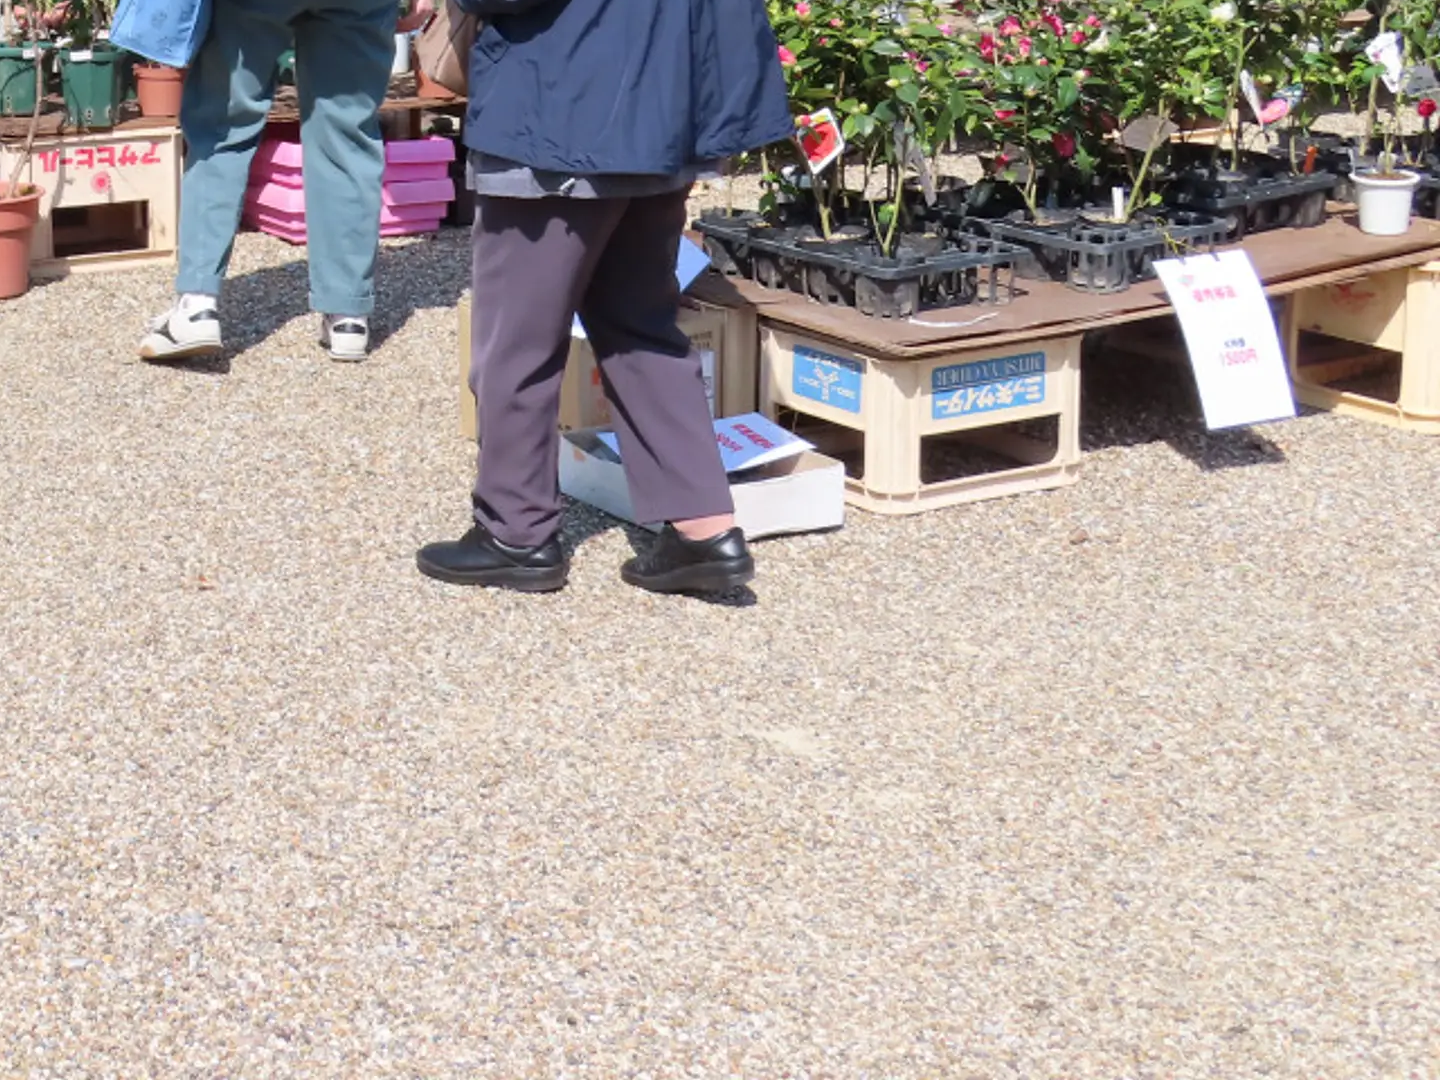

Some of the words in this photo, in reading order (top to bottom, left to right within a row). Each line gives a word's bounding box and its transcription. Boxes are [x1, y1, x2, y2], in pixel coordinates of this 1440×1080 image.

[39, 143, 161, 173] アサヒビール
[936, 376, 1042, 414] 三ツ矢サイダー
